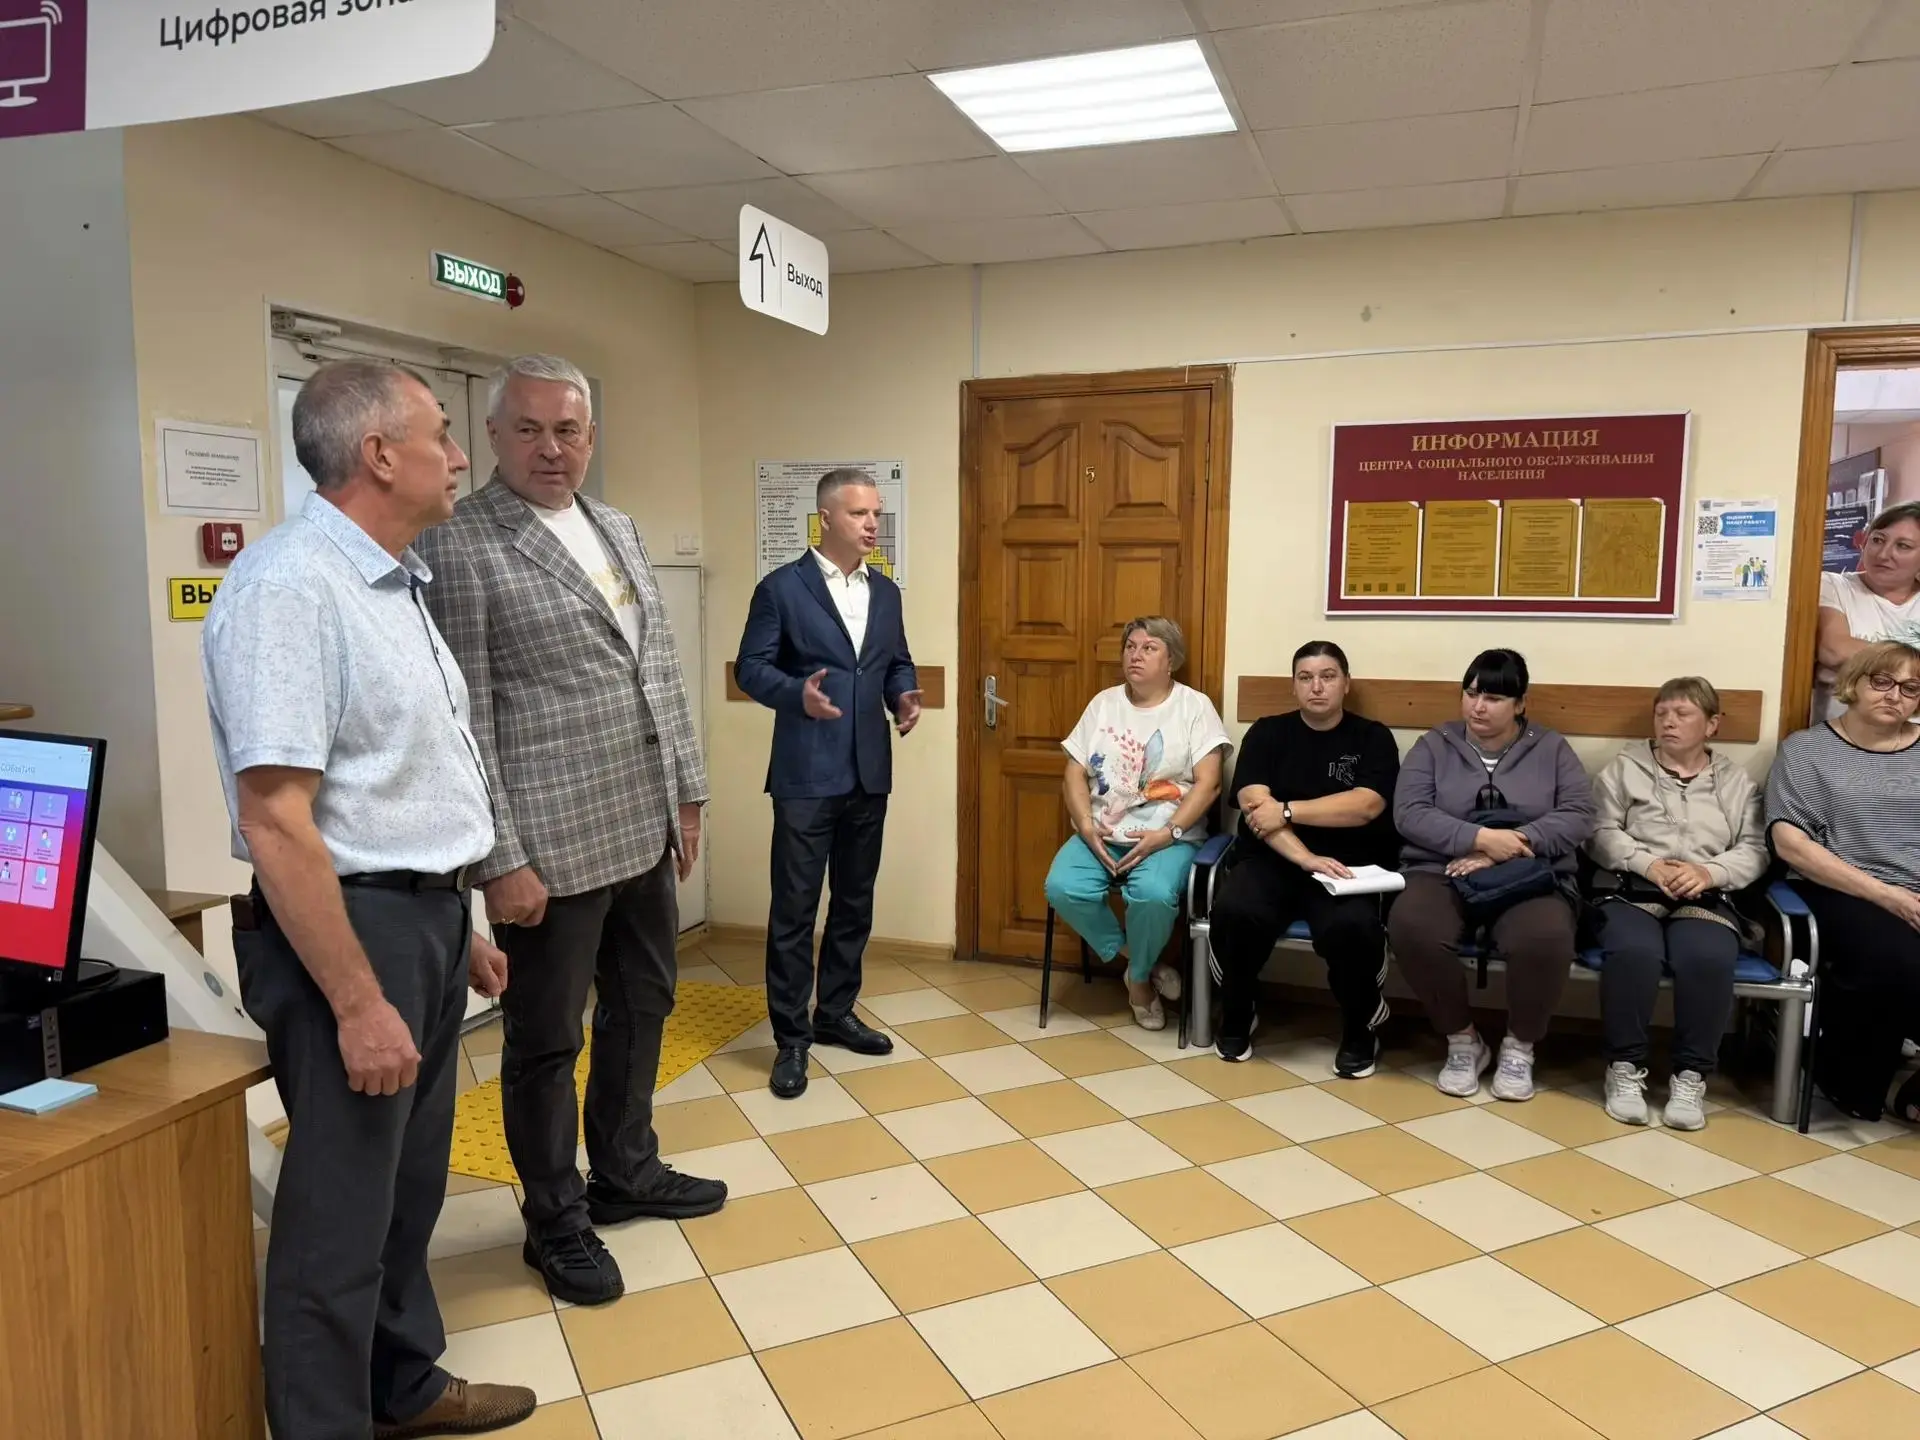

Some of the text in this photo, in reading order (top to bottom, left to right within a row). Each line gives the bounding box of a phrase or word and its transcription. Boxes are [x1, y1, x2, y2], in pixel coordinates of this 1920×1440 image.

[160, 0, 326, 50] Цифровая
[443, 259, 501, 296] ВЫХОД
[787, 262, 823, 298] Выход
[1411, 429, 1600, 452] ИНФОРМАЦИЯ
[1359, 453, 1654, 472] ЦЕНТРА СОЦИАЛЬНОГО ОБСЛУЖИВАНИЯ
[1085, 466, 1096, 484] 5
[1458, 469, 1545, 481] НАСЕЛЕНИЯ
